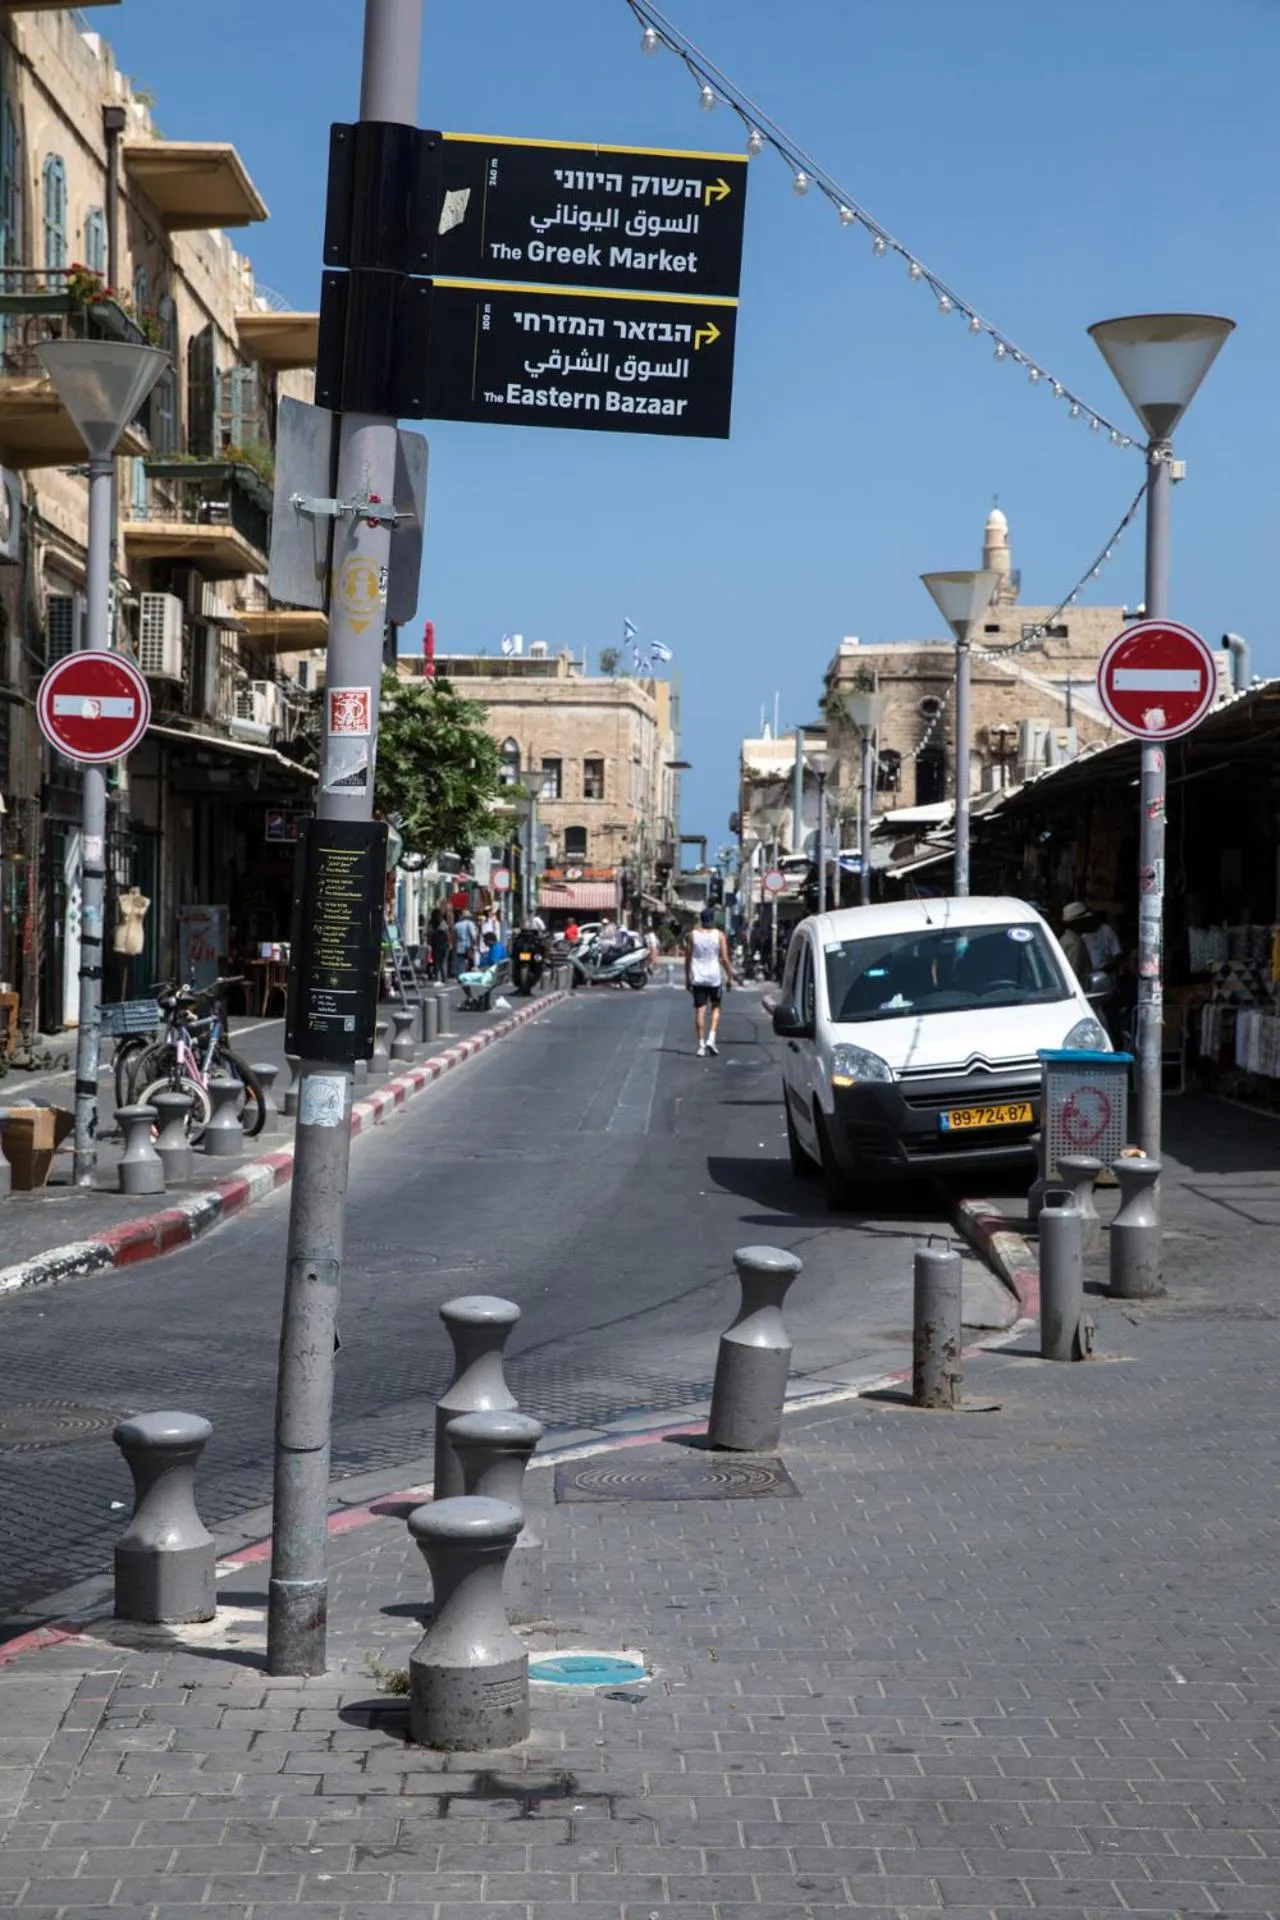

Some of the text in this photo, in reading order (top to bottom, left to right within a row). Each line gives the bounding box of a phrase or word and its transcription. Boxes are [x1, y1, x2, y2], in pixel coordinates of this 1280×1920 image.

[553, 169, 702, 199] השוק היווני
[530, 203, 700, 237] السوق اليوناني
[490, 240, 698, 273] The Greek Market
[513, 311, 692, 343] הבזאר המזרחי
[524, 348, 690, 382] السوق الشرقي
[483, 383, 688, 415] The Eastern Bazaar
